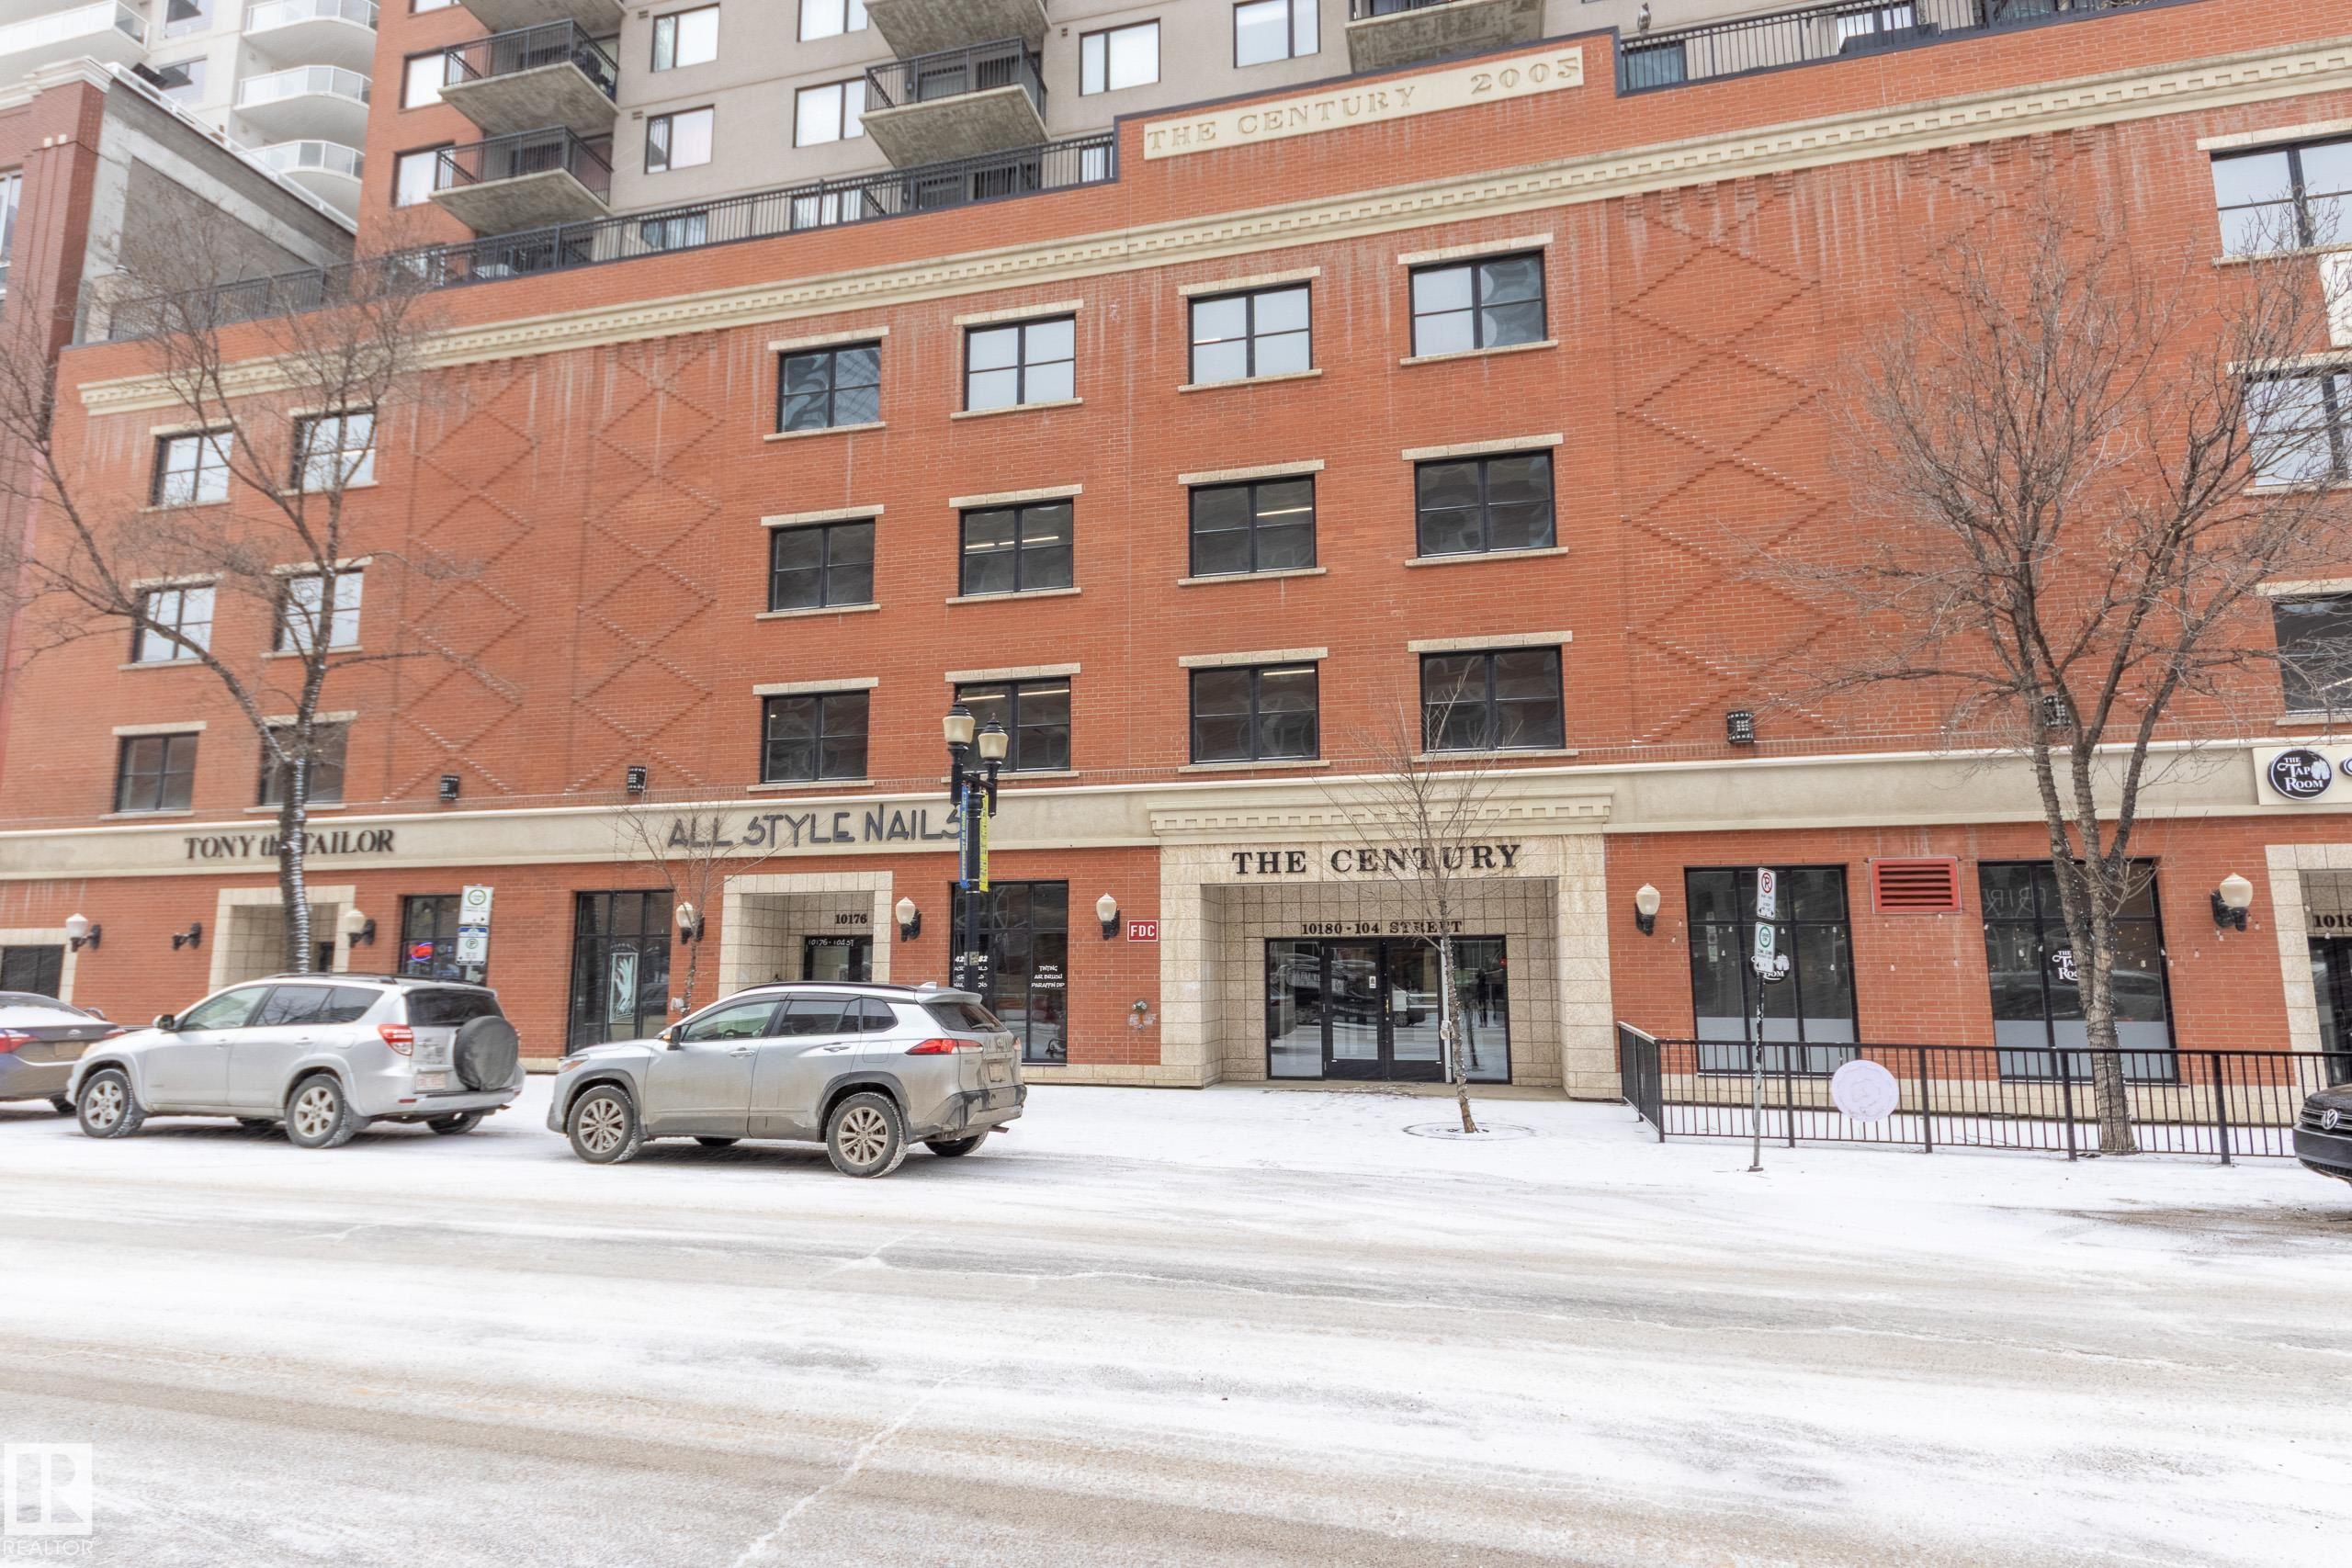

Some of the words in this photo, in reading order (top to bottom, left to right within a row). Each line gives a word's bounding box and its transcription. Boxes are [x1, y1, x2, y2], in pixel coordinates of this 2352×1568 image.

[1148, 120, 1216, 151] THE
[1238, 85, 1416, 134] CENTURY
[1470, 56, 1579, 95] 2005
[2277, 762, 2311, 778] TAP
[2284, 776, 2324, 792] ROOM
[667, 817, 733, 847] ALL
[742, 812, 855, 848] STYLE
[865, 803, 960, 841] NAILS
[185, 835, 255, 859] TONY
[302, 829, 394, 854] TAILOR
[1232, 850, 1306, 874] THE
[1330, 843, 1521, 872] CENTURY
[835, 913, 867, 925] 10176
[1130, 924, 1156, 937] FDC
